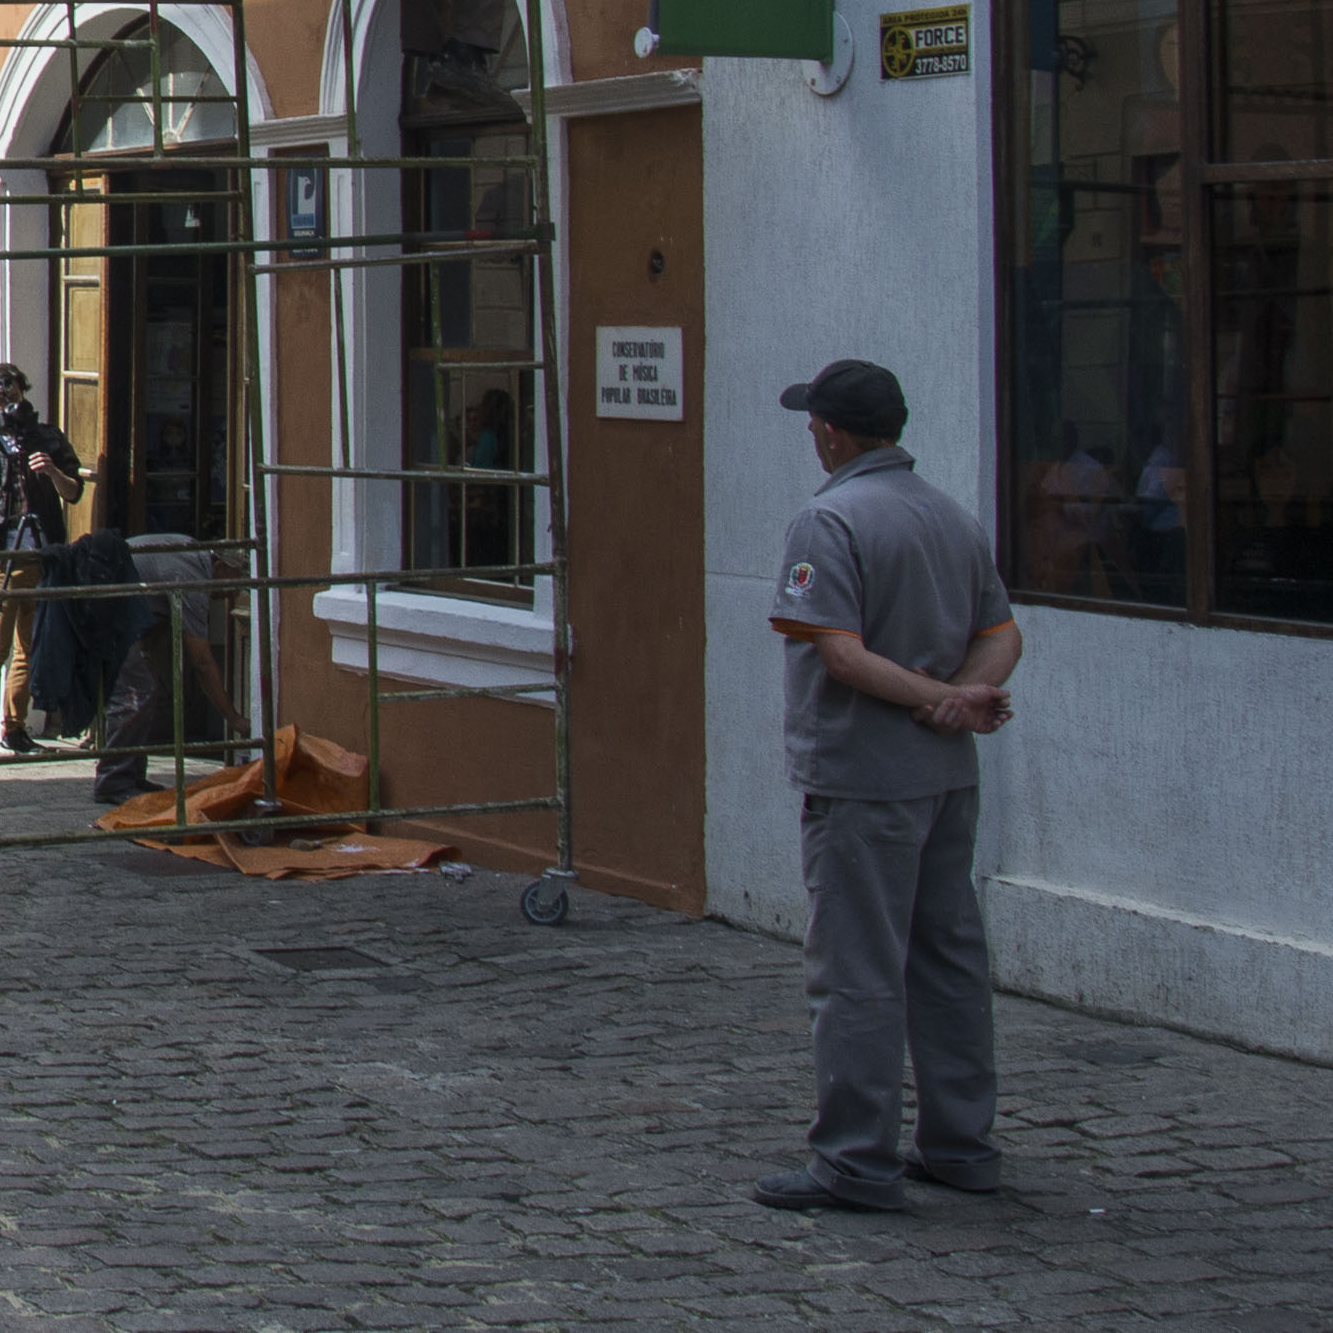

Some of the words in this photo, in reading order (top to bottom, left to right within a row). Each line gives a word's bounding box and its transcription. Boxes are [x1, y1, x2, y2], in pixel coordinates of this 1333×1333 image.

[915, 26, 965, 47] FORCE
[612, 338, 665, 359] CONSERVATÓRIO
[619, 363, 629, 382] DE
[632, 361, 659, 382] MÚSICA
[600, 386, 632, 405] POPULAR
